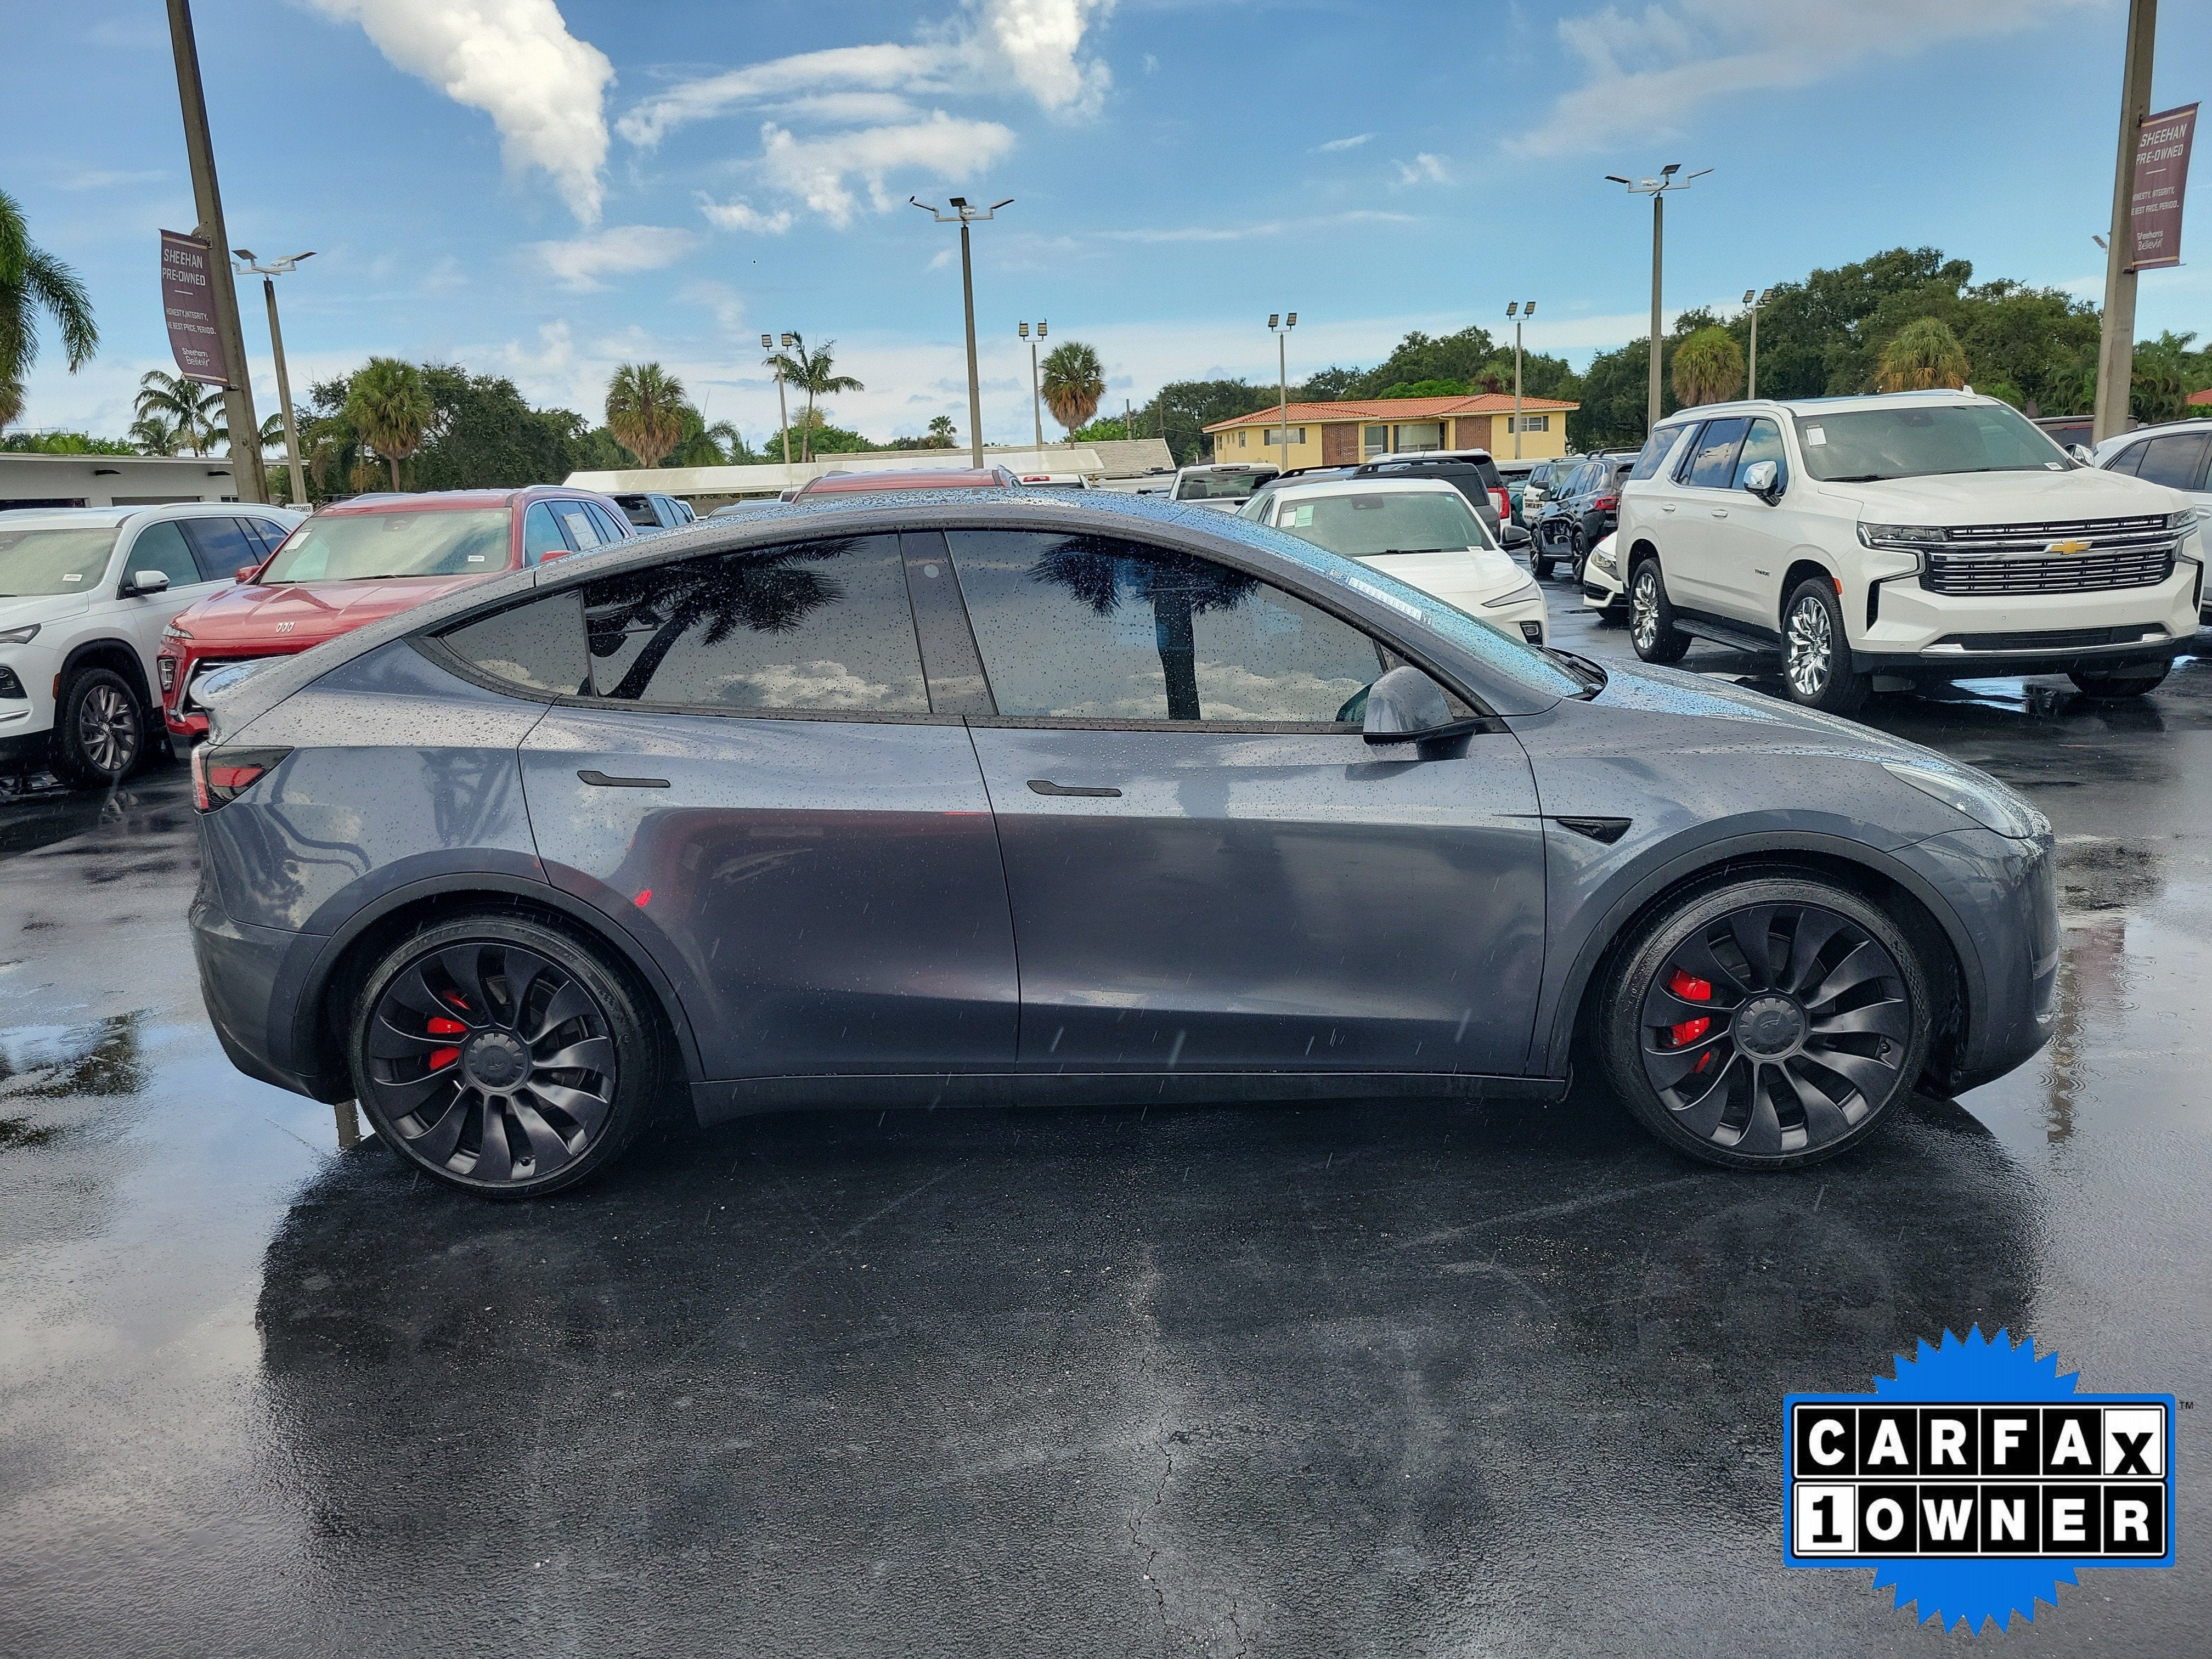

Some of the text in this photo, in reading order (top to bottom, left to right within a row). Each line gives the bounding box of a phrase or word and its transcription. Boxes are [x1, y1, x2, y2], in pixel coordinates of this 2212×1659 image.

[2140, 123, 2187, 148] SHEEHAN
[2136, 144, 2183, 165] PRE-OWNED
[164, 249, 202, 269] SHEEHAN
[162, 267, 206, 286] PRE-OWNED
[197, 325, 217, 335] PERIOD.
